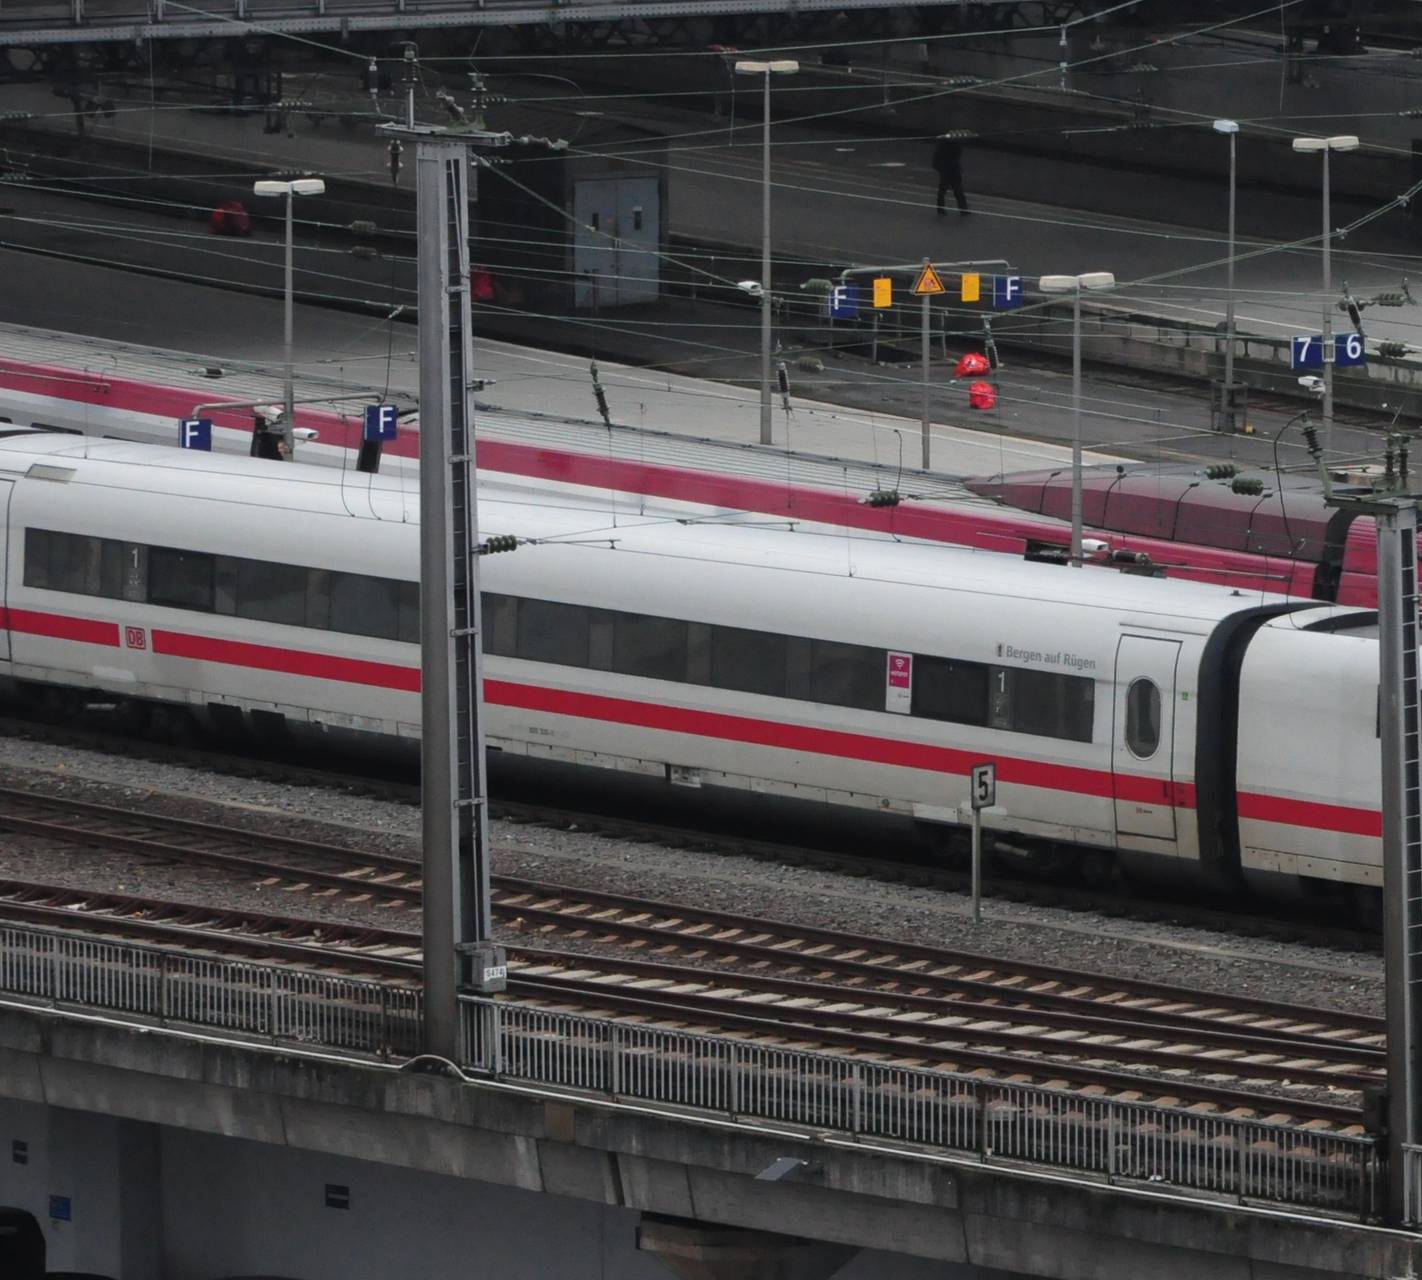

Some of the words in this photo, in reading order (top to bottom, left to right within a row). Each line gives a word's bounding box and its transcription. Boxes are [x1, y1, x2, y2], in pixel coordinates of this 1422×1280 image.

[834, 285, 848, 311] F
[1006, 276, 1020, 301] F
[1297, 336, 1312, 362] 7
[1346, 333, 1361, 359] 6
[379, 406, 393, 434] F
[185, 421, 200, 448] F
[131, 547, 139, 569] 1
[127, 628, 145, 648] DB
[1006, 645, 1042, 663] Bergen
[1044, 652, 1061, 664] auf
[1063, 653, 1096, 671] Rügen
[998, 671, 1005, 693] 1
[978, 770, 989, 801] 5
